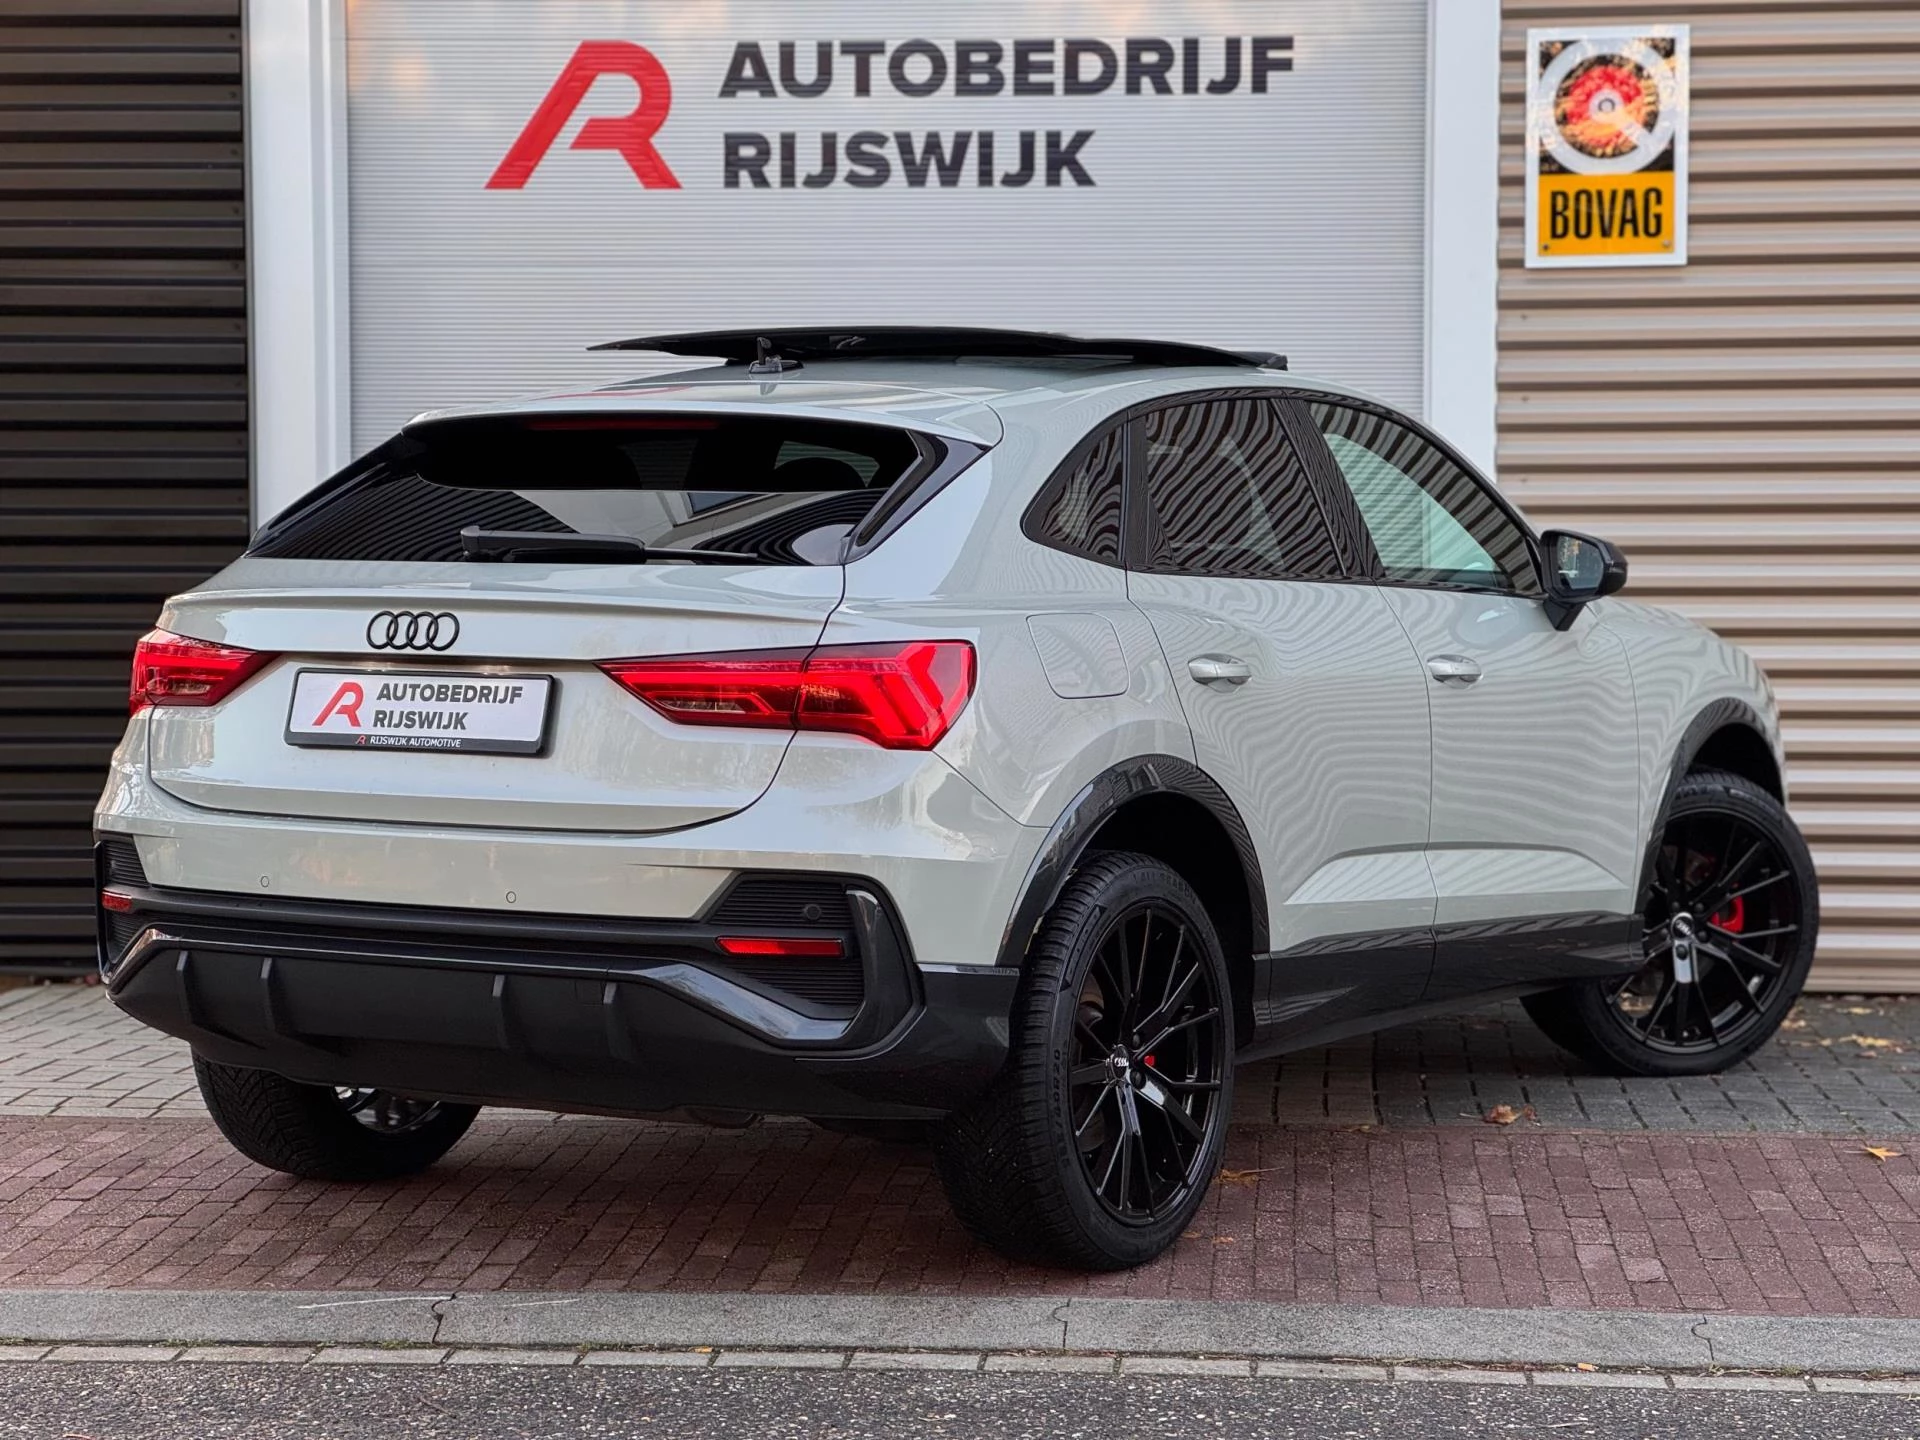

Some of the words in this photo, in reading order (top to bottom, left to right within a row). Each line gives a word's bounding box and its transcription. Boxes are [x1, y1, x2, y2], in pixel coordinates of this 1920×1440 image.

[718, 36, 1294, 98] AUTOBEDRIJF
[723, 130, 1097, 189] RIJSWIJK
[1550, 187, 1663, 239] BOVAG
[376, 683, 523, 704] AUTOBEDRIJF
[373, 710, 468, 730] RIJSWIJK
[370, 736, 407, 746] RIJSWIJK
[408, 738, 461, 748] AUTOMOTIVE
